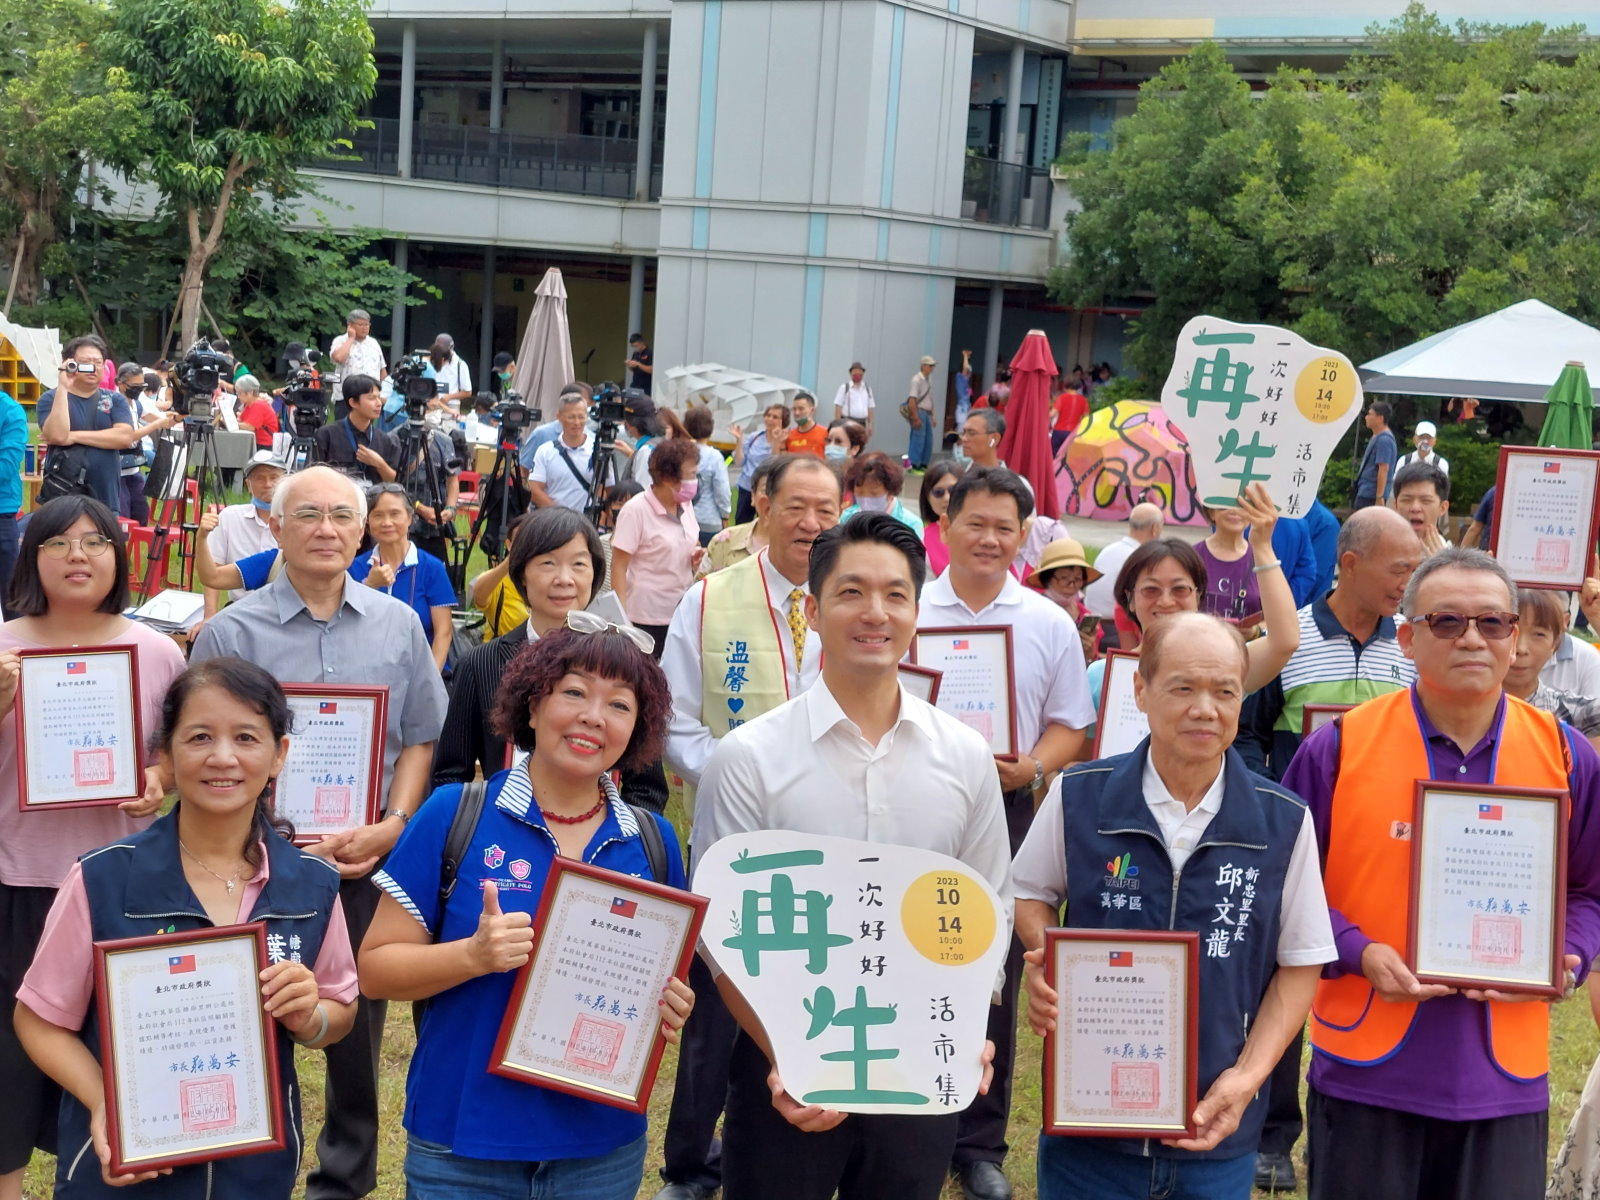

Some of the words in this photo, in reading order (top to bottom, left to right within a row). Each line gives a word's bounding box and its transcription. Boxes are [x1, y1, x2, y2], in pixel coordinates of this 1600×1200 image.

[1260, 342, 1291, 426] 一次好好
[1320, 369, 1337, 382] 10
[1316, 388, 1333, 402] 14
[1287, 443, 1312, 515] 活市集
[936, 877, 958, 885] 2023
[1104, 876, 1139, 890] TAIPEI
[937, 888, 960, 905] 10
[1100, 892, 1142, 911] 萬華區
[1233, 866, 1260, 942] 新忠里里長
[858, 857, 887, 976] 一次好好
[1206, 862, 1243, 959] 邱文龍
[938, 916, 962, 933] 14
[939, 937, 963, 945] 10:00
[722, 848, 930, 1105] 再生
[154, 979, 212, 994] 臺北市政府獎狀
[930, 995, 959, 1106] 活市集
